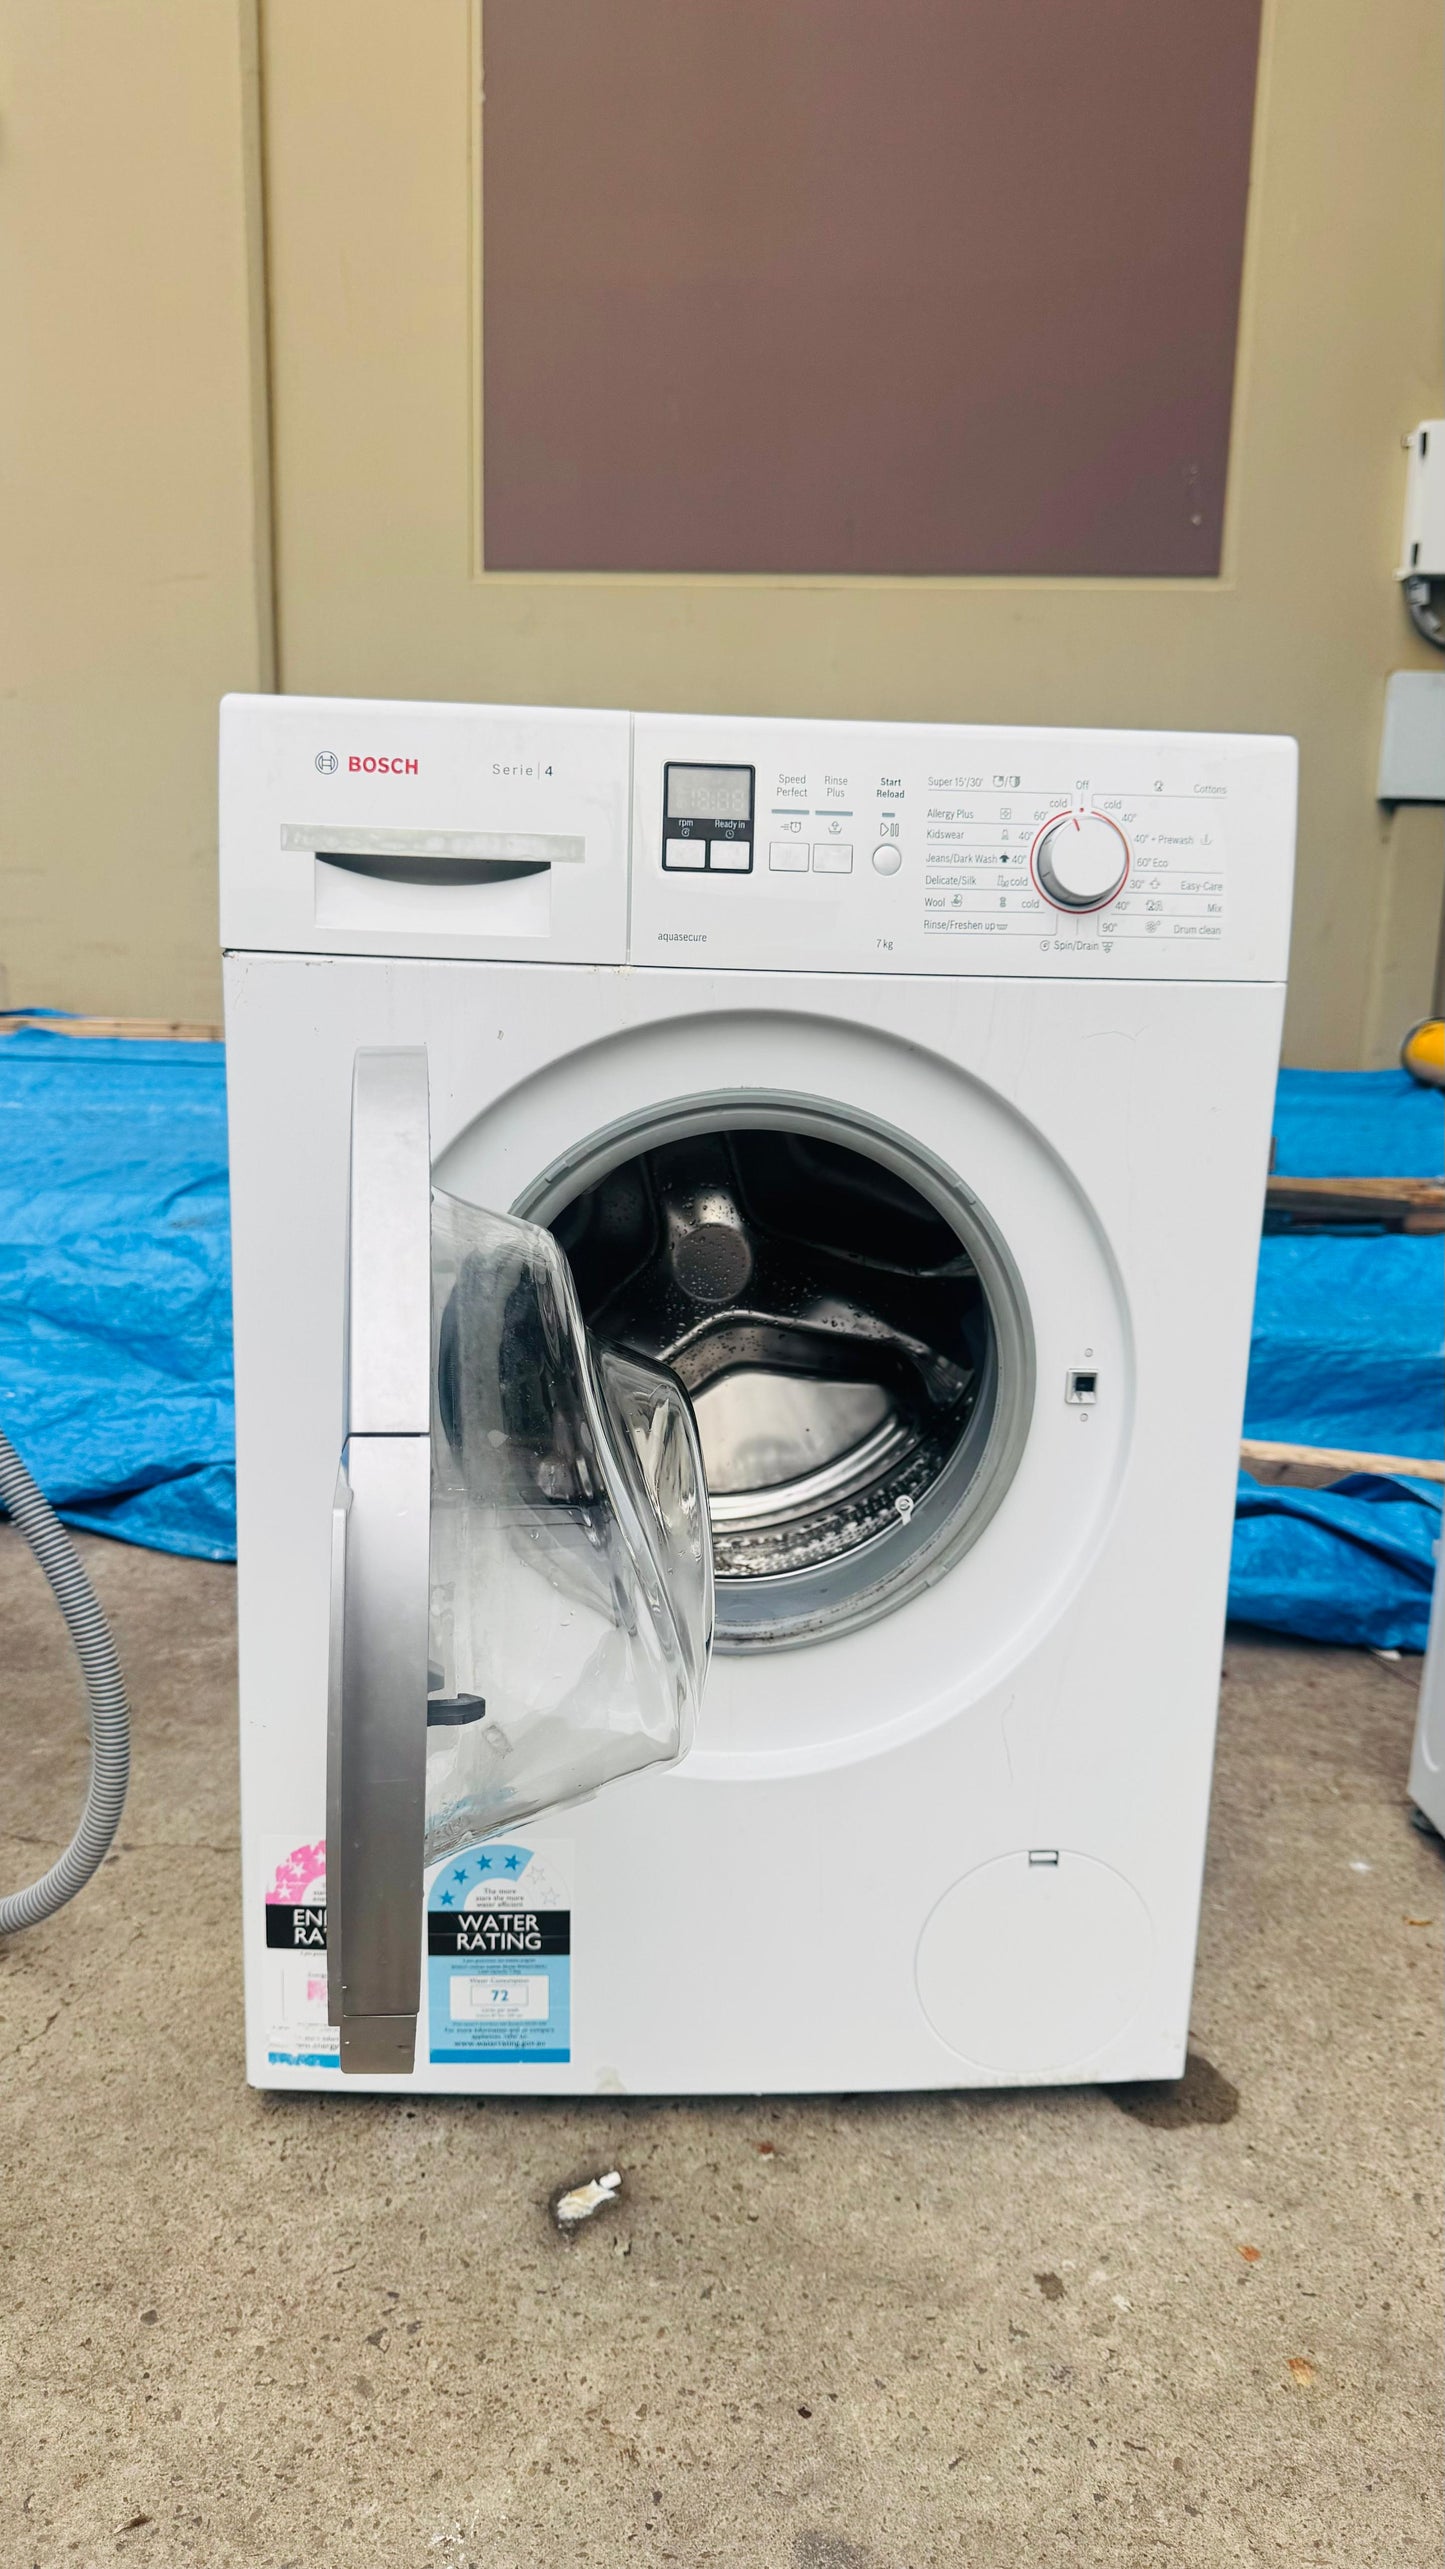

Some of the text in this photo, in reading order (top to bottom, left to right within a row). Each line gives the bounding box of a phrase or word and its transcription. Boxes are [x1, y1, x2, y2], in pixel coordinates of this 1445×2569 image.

[348, 756, 419, 775] BOSCH
[492, 763, 553, 776] Serie 4
[778, 773, 807, 785] Speed
[824, 775, 849, 786] Rinse
[880, 777, 902, 787] Start
[927, 776, 953, 788] Super
[1075, 779, 1090, 790] Off
[776, 787, 808, 798] Perfect
[826, 788, 845, 798] Plus
[876, 789, 905, 799] Reload
[1193, 783, 1228, 795] Cottons
[1049, 799, 1068, 809] cold
[1103, 800, 1122, 810] cold
[926, 808, 974, 820] Allergy Plus
[678, 819, 694, 828] rpm
[714, 819, 746, 830] Ready in
[926, 829, 965, 840] Kidswear
[1158, 834, 1195, 845] Prewash
[925, 852, 998, 864] Jeans/Dark Wash
[1152, 858, 1169, 868] Eco
[925, 874, 977, 886] Delicate/Silk
[1010, 876, 1029, 887] cold
[1180, 880, 1223, 892] Easy-Care
[924, 897, 946, 908] Wool
[1021, 899, 1040, 909] cold
[1207, 903, 1223, 914] Mix
[923, 919, 996, 932] Rinse/Freshen up
[1173, 924, 1222, 935] Drum clean
[657, 931, 708, 943] aquasecure
[876, 938, 894, 950] 7 kg
[1053, 940, 1099, 951] Spin/Drain
[458, 1914, 540, 1932] WATER
[457, 1931, 542, 1951] RATING
[491, 1989, 509, 2002] 72
